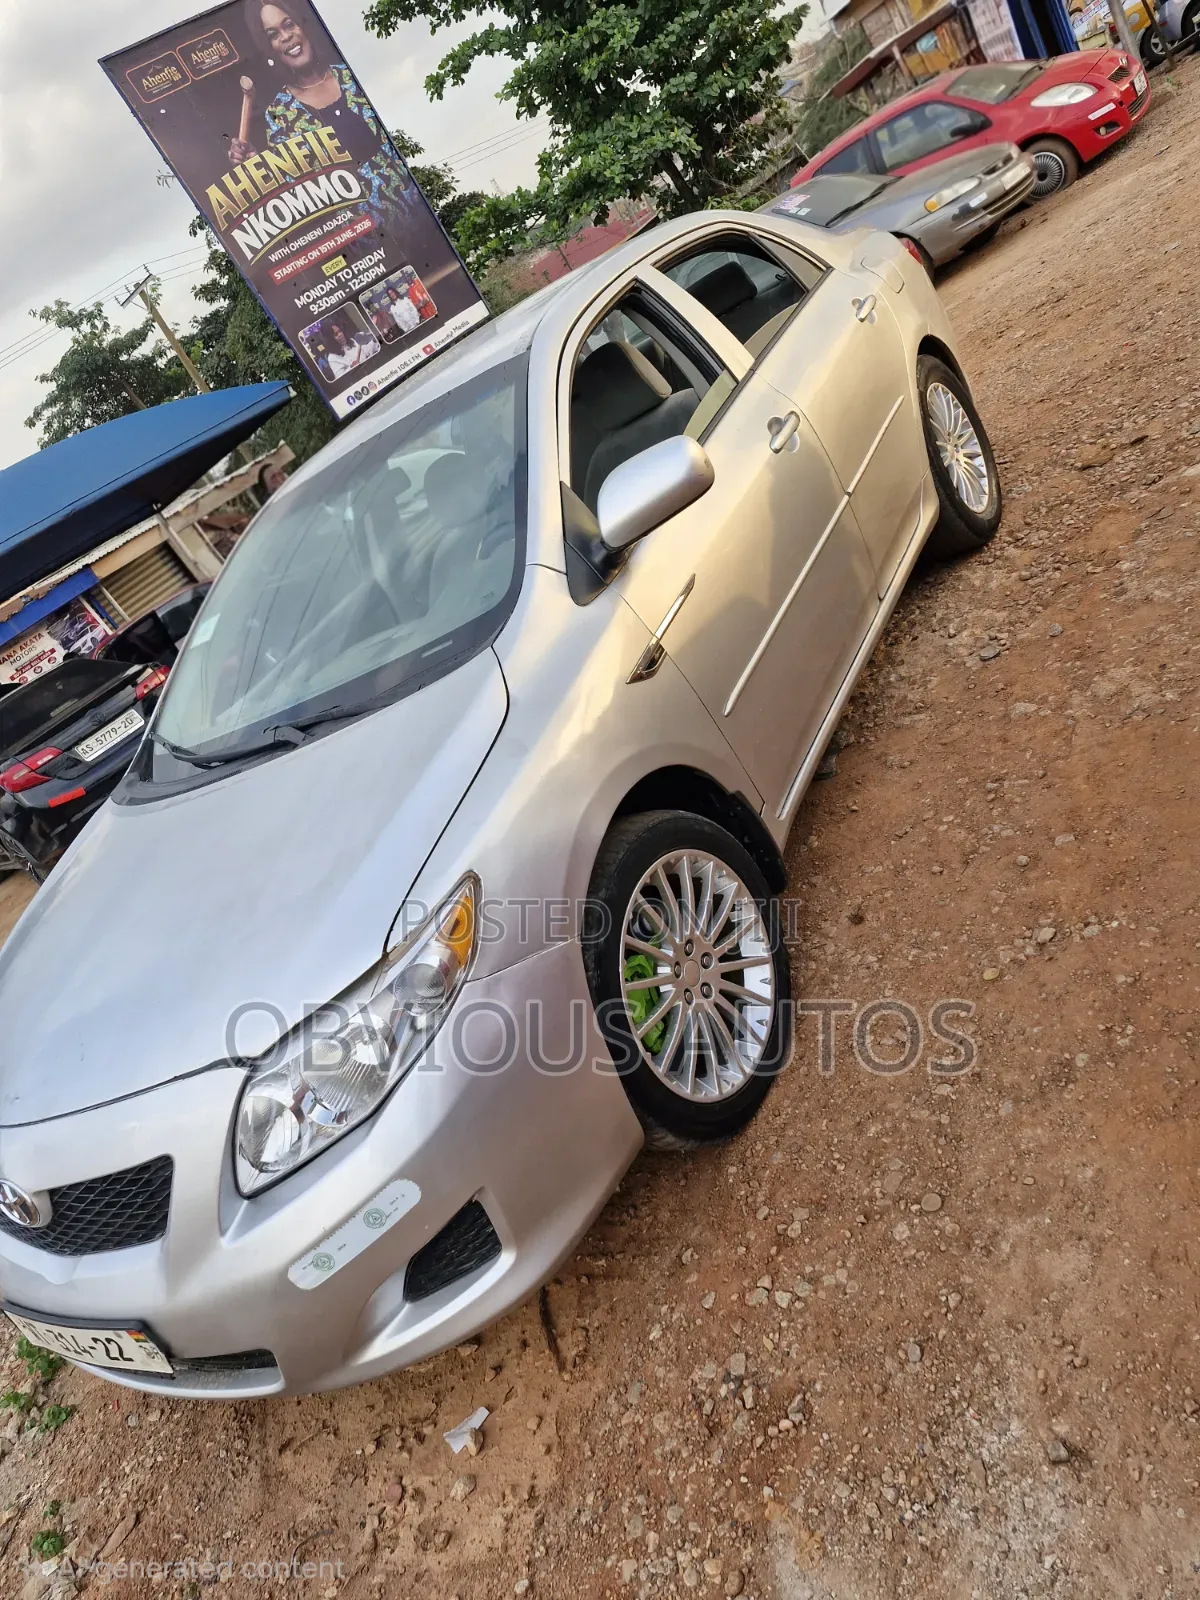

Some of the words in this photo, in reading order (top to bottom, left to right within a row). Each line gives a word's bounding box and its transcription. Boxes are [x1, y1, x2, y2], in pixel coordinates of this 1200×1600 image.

[142, 66, 178, 90] Ahenfie
[191, 41, 226, 64] Ahenfie
[205, 126, 352, 231] AHENFIE
[230, 169, 362, 260] NKOMMO
[268, 247, 291, 263] WITH
[289, 227, 324, 251] OHENENI
[322, 210, 354, 233] ADAZOA
[273, 257, 309, 280] STARTING
[307, 248, 321, 260] ON
[318, 238, 337, 254] 15TH
[334, 229, 357, 246] JUNE,
[354, 219, 372, 234] 2026
[325, 259, 343, 273] EVERY
[294, 275, 339, 308] MONDAY
[337, 269, 352, 282] TO
[351, 247, 386, 274] FRIDAY
[309, 289, 346, 315] 9:30am
[348, 263, 387, 291] 12:30PM
[377, 368, 399, 386] Ahenfie
[412, 353, 422, 362] FM
[452, 319, 470, 333] Media
[9, 644, 37, 666] MOTORS
[19, 632, 45, 652] AKATA
